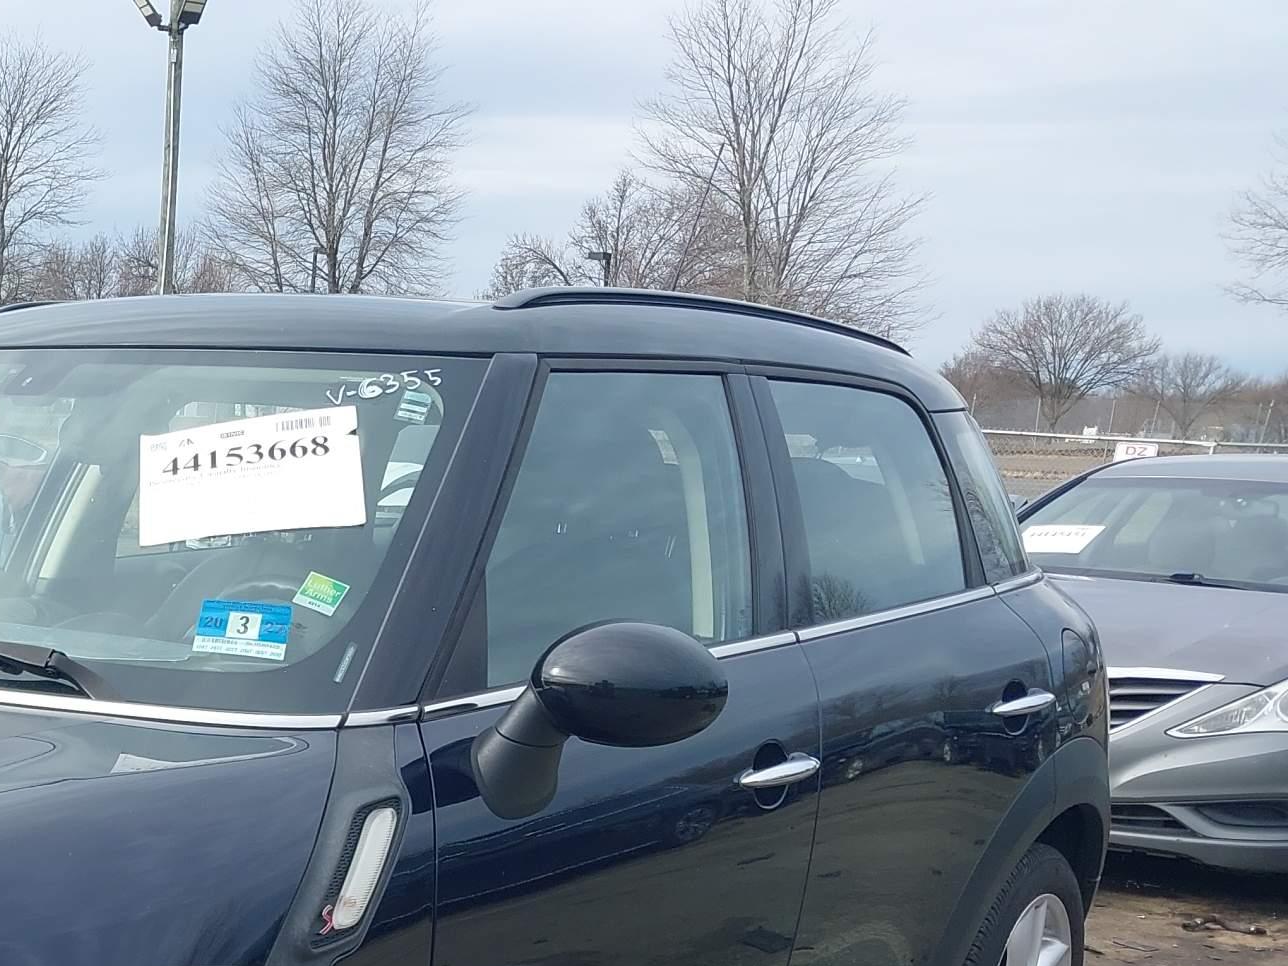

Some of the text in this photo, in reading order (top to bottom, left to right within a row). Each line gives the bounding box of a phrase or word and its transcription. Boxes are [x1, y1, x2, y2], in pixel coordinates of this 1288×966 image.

[161, 435, 331, 476] 44153668
[304, 588, 333, 604] Arms
[236, 615, 251, 635] 3
